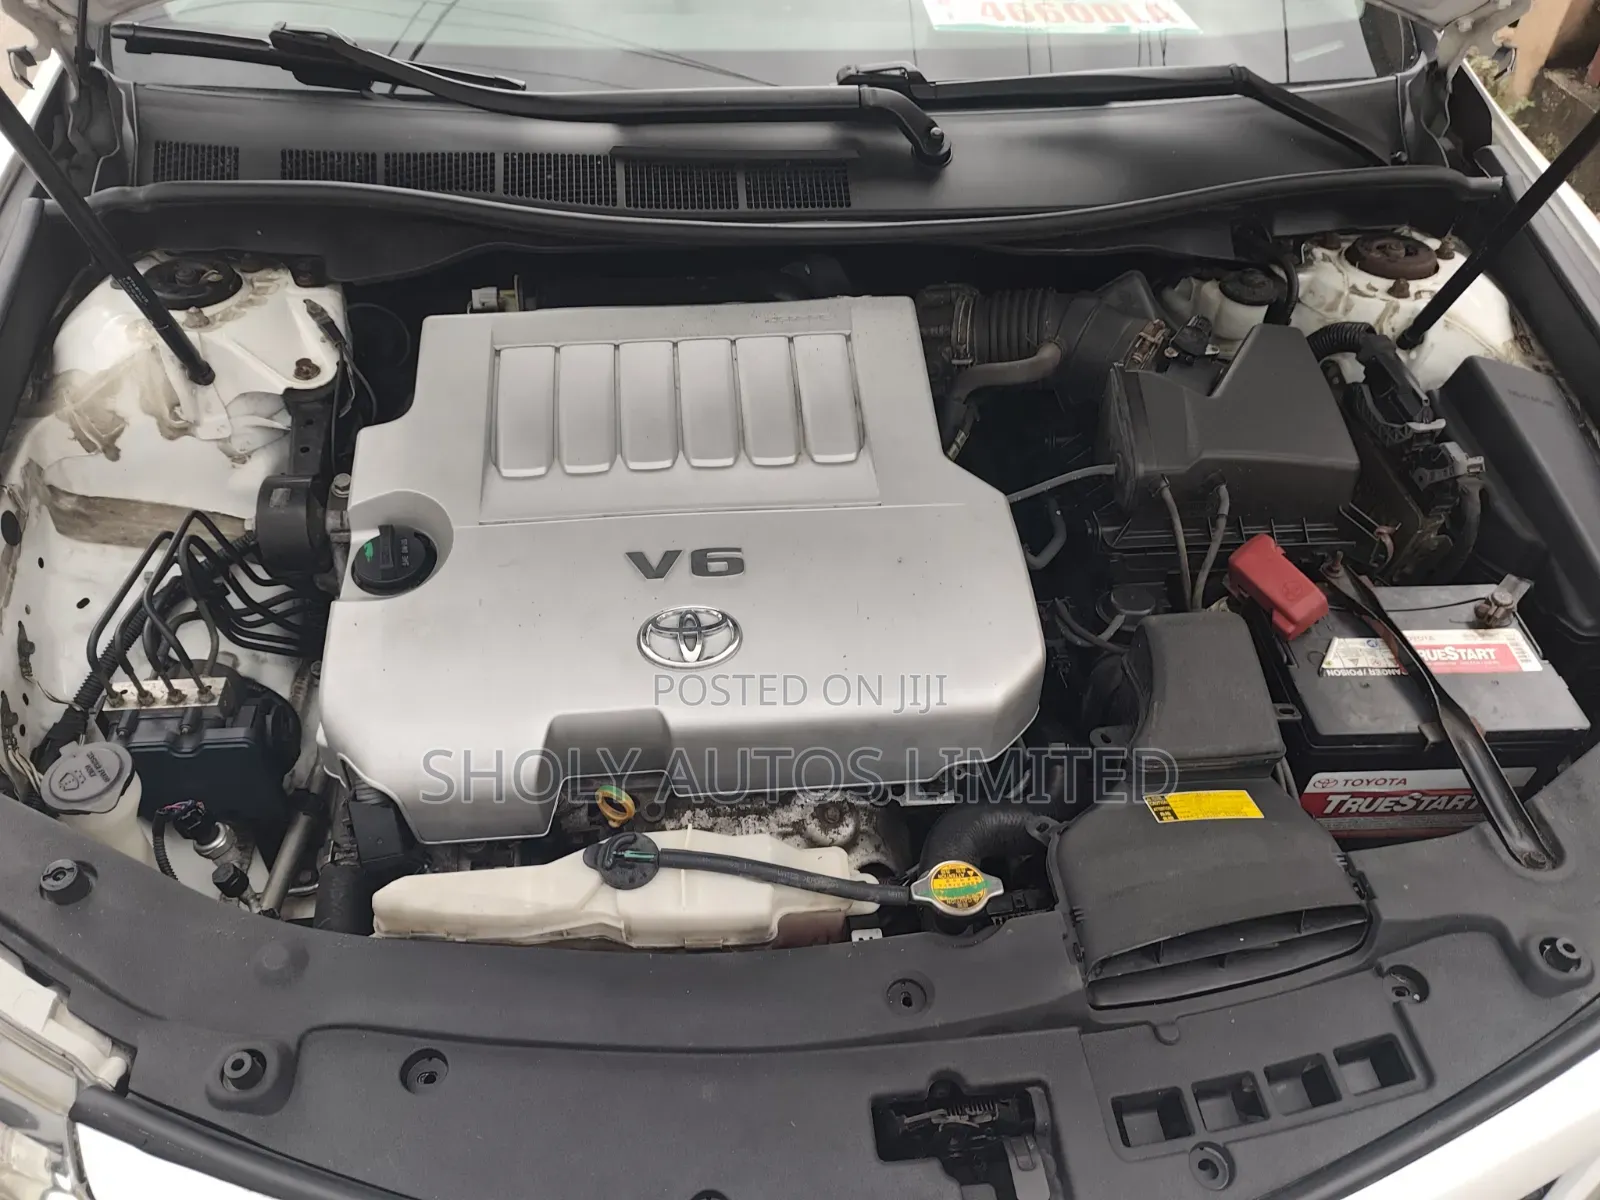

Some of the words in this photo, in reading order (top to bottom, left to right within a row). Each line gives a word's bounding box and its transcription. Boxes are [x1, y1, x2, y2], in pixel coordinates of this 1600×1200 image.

[624, 546, 746, 581] V6
[1417, 645, 1497, 662] RUESTART
[1342, 777, 1408, 787] TOYOTA
